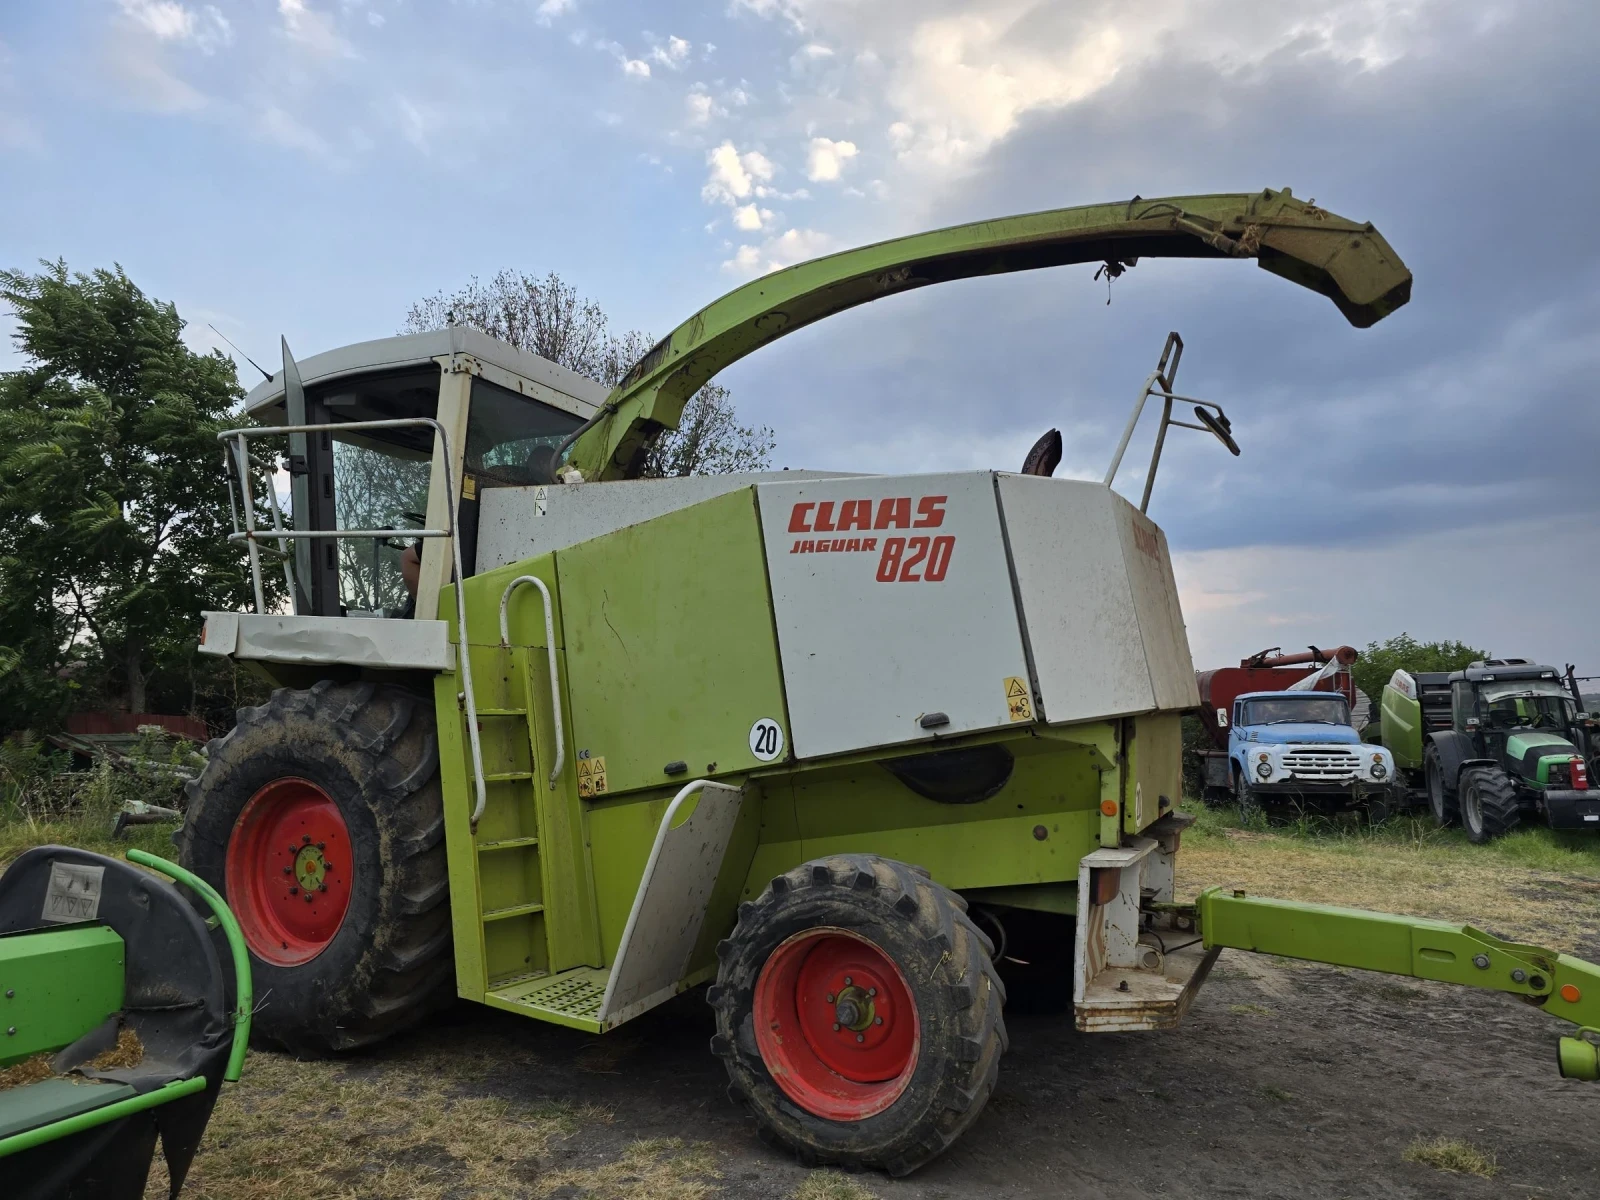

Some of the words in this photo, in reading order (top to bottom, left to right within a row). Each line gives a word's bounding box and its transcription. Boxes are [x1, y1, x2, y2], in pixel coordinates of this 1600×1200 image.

[787, 495, 948, 533] CLAAS
[789, 537, 878, 554] JAGUAR
[875, 535, 956, 583] 820
[755, 724, 778, 755] 20
